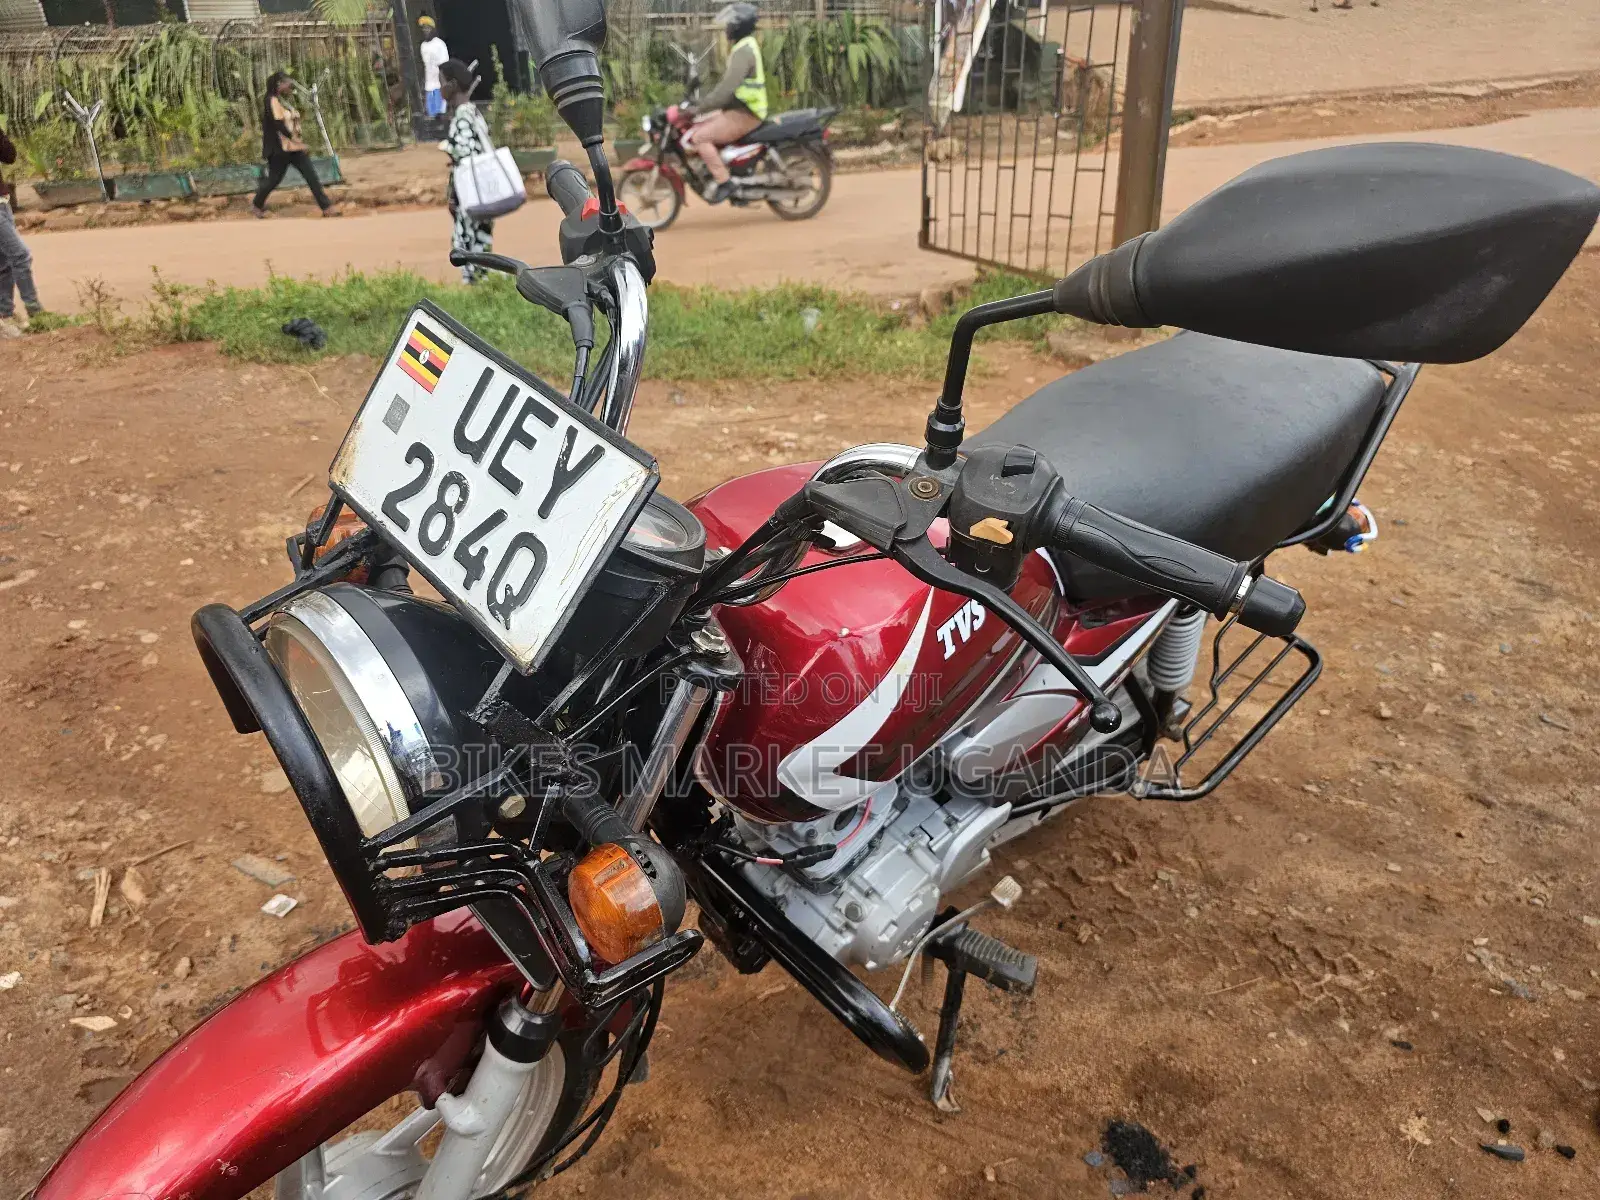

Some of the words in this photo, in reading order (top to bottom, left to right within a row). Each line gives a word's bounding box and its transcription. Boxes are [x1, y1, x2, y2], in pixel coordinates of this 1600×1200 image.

[453, 366, 605, 519] UEY
[381, 441, 548, 630] 284Q
[936, 598, 986, 661] TVS
